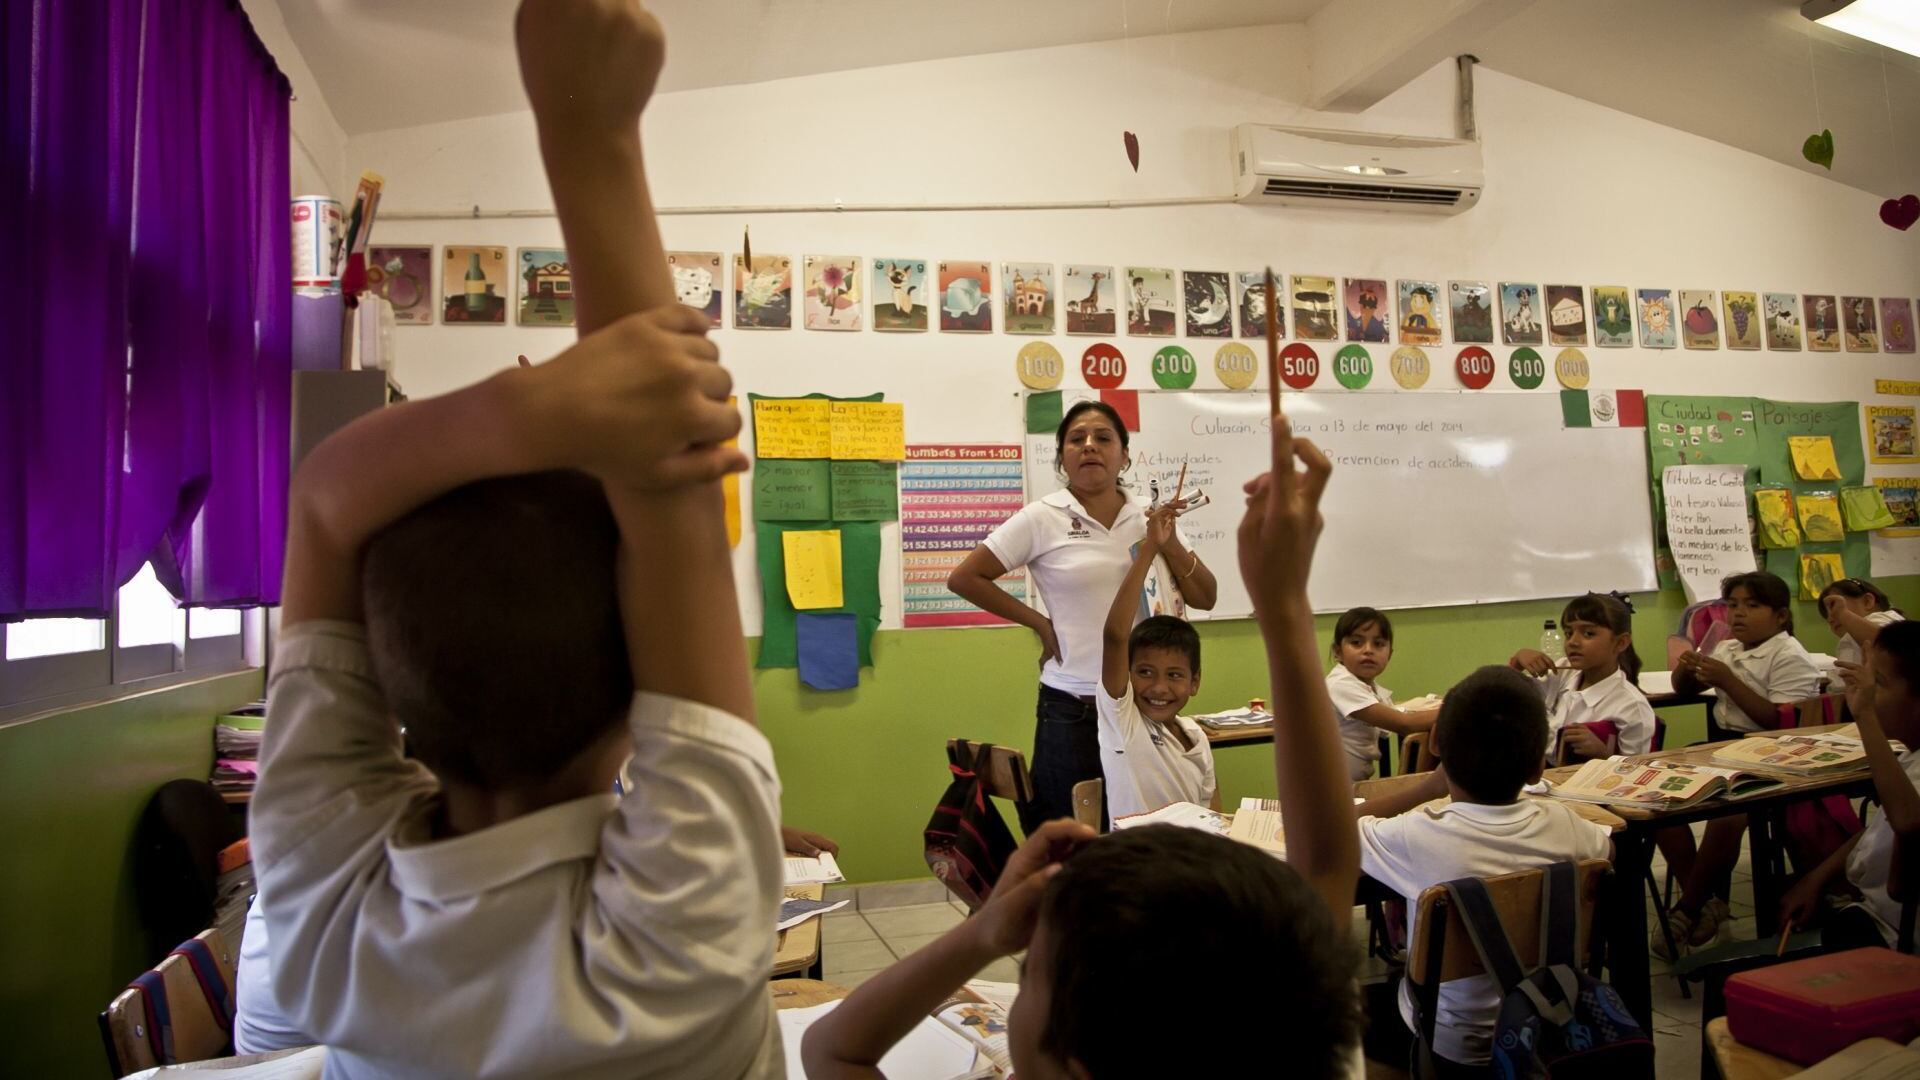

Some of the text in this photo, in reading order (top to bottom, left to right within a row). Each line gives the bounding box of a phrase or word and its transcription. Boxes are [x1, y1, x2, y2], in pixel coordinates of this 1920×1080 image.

[712, 255, 720, 266] d
[875, 260, 925, 274] G g
[940, 263, 988, 273] H h
[1128, 268, 1135, 278] K
[1452, 282, 1459, 292] O
[1023, 355, 1058, 377] 100
[1086, 355, 1123, 377] 200
[1156, 353, 1192, 374] 300
[1218, 353, 1251, 373] 400
[1284, 356, 1317, 377] 500
[1339, 357, 1369, 375] 600
[1395, 356, 1425, 375] 700
[1460, 356, 1491, 375] 800
[1513, 359, 1543, 377] 900
[831, 402, 846, 414] La
[1660, 400, 1711, 420] Ciudad
[1763, 403, 1833, 431] Paisajes
[1260, 417, 1311, 432] Sloa
[1319, 424, 1329, 432] a
[1333, 419, 1345, 432] 13
[1353, 419, 1370, 432] de
[1376, 422, 1407, 436] mayo
[1415, 421, 1433, 432] del
[1441, 421, 1463, 432] 2014
[904, 448, 956, 457] Numbers
[960, 449, 987, 457] From
[989, 449, 1018, 458] 1-100
[1136, 451, 1223, 467] Actividades
[1408, 455, 1423, 468] de
[775, 467, 811, 477] mayor
[1704, 473, 1717, 486] de
[775, 484, 814, 494] menor
[779, 498, 806, 514] igual
[1669, 496, 1682, 508] Un
[1688, 494, 1716, 508] tesoro
[914, 511, 925, 519] 32
[927, 511, 938, 519] 33
[939, 511, 950, 519] 34
[951, 511, 962, 519] 35
[964, 511, 975, 519] 36
[977, 511, 987, 519] 37
[1670, 509, 1711, 523] Peter Pan
[903, 525, 987, 533] 41 42 43 44 45 46 47
[1672, 524, 1682, 534] La
[1684, 525, 1703, 535] bella
[903, 541, 976, 549] 51 52 53 54 55 56
[1688, 541, 1719, 551] medias
[1721, 541, 1732, 552] de
[1734, 541, 1749, 552] los
